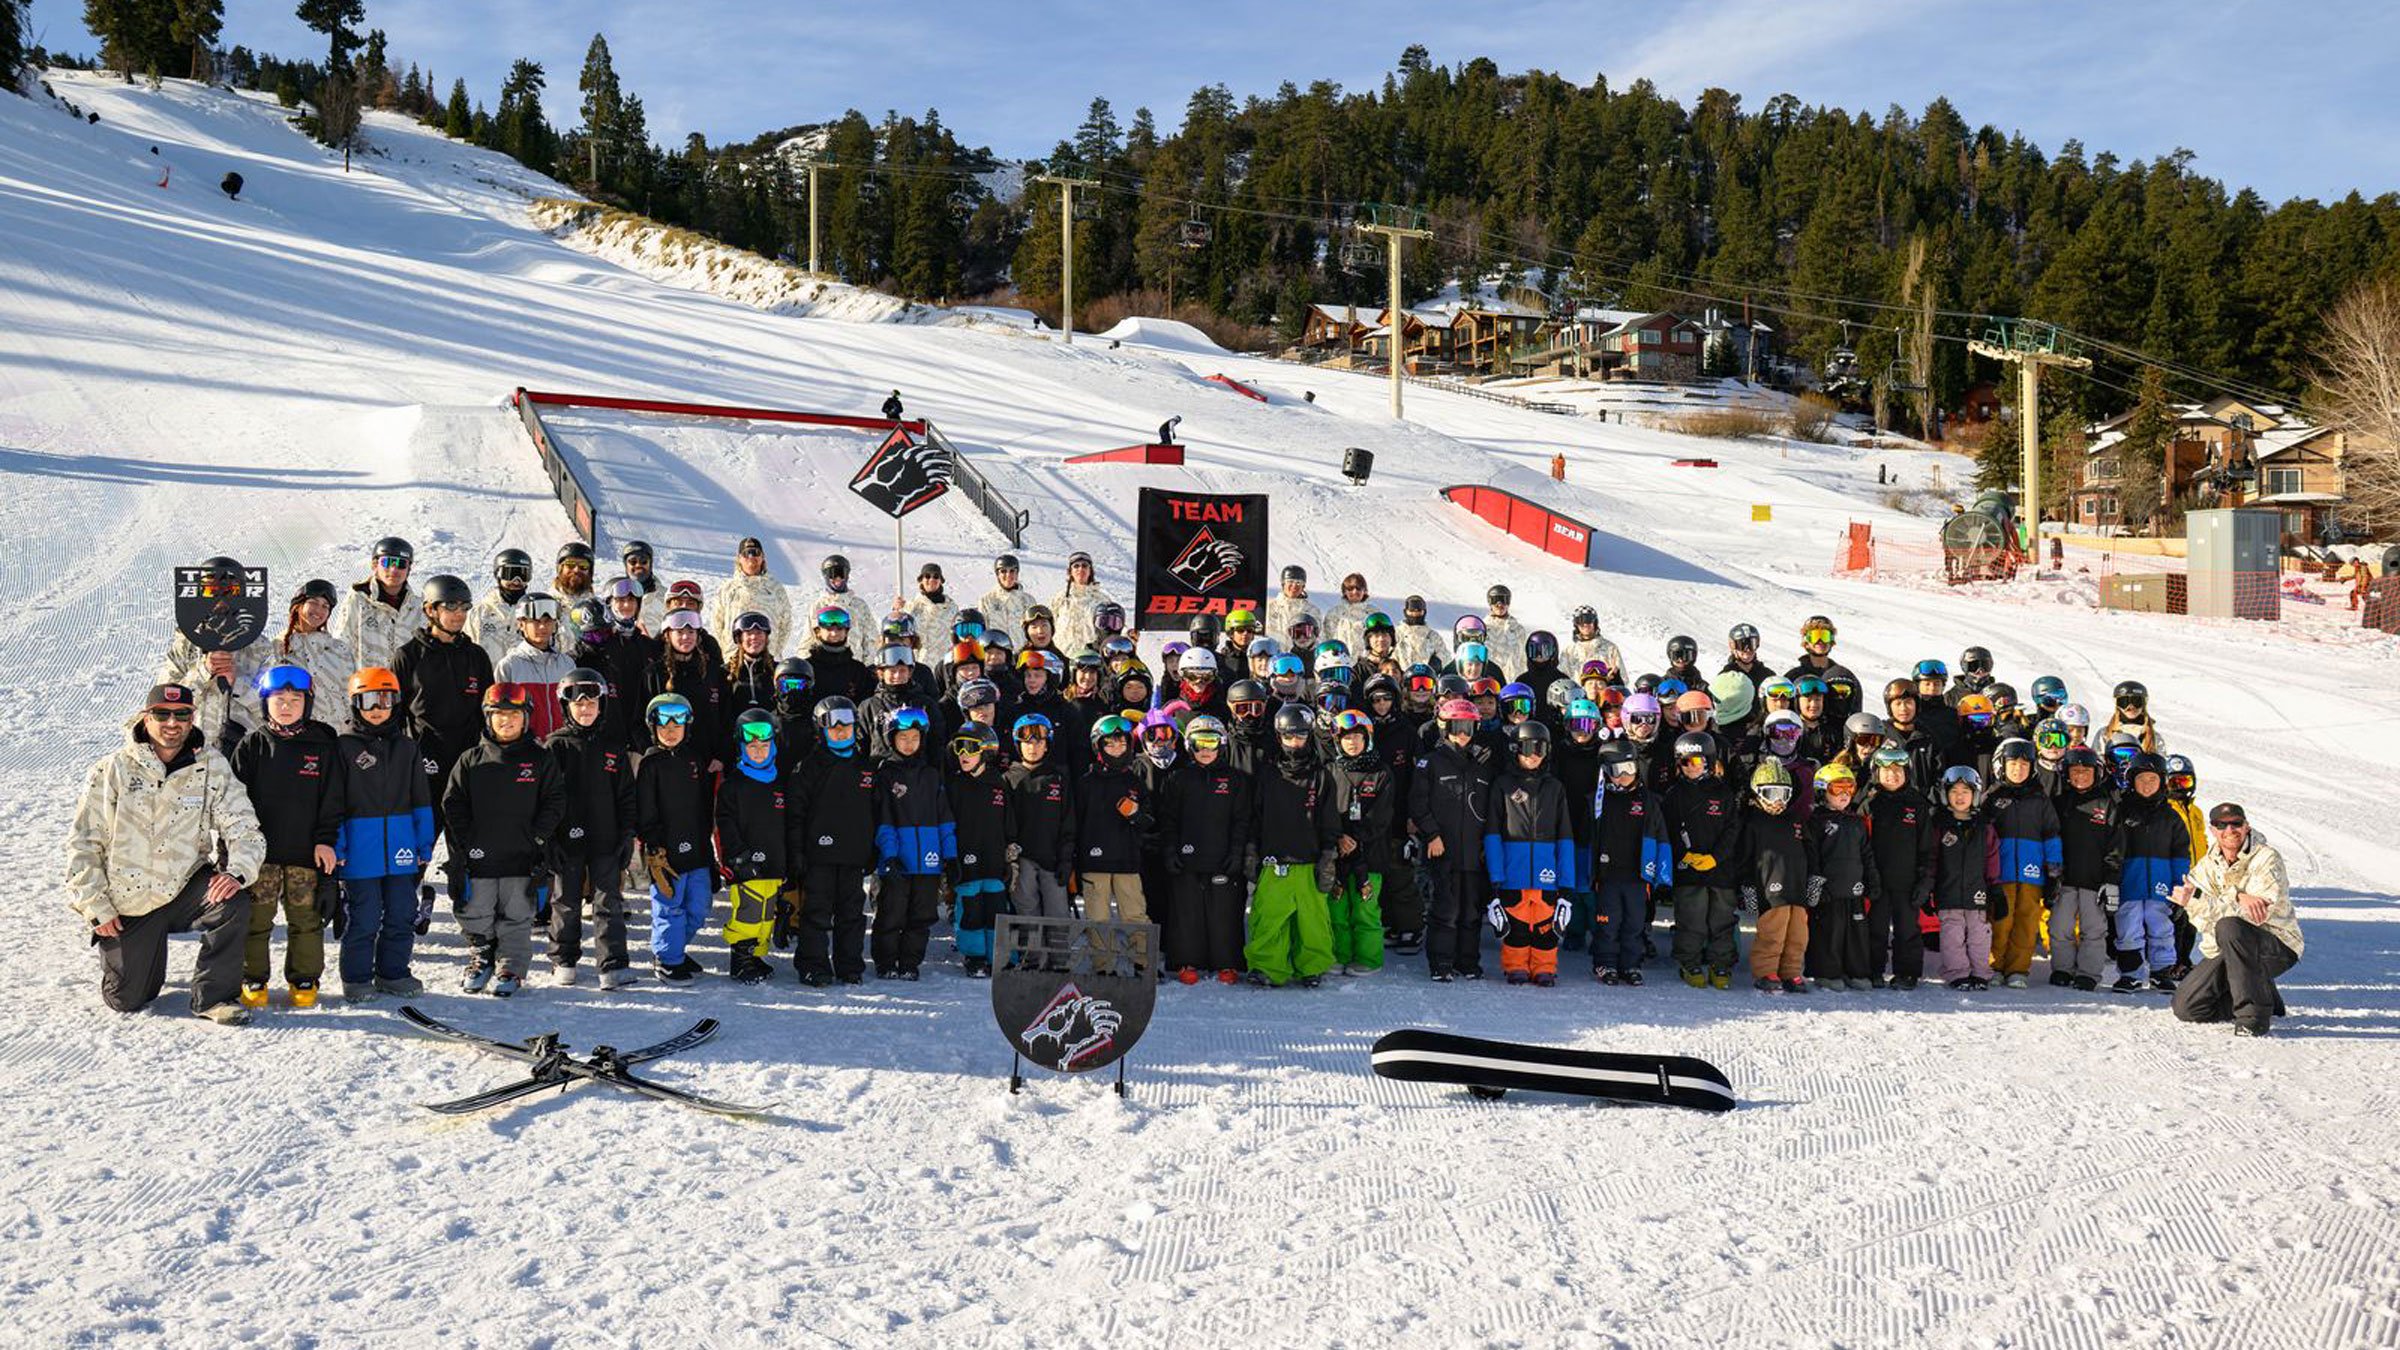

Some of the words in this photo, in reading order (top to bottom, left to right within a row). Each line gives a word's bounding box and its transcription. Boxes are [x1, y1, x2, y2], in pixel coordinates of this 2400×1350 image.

[1168, 499, 1243, 523] TEAM
[1553, 522, 1585, 543] BEAR
[181, 570, 262, 582] TEM
[1008, 922, 1148, 953] TEAM
